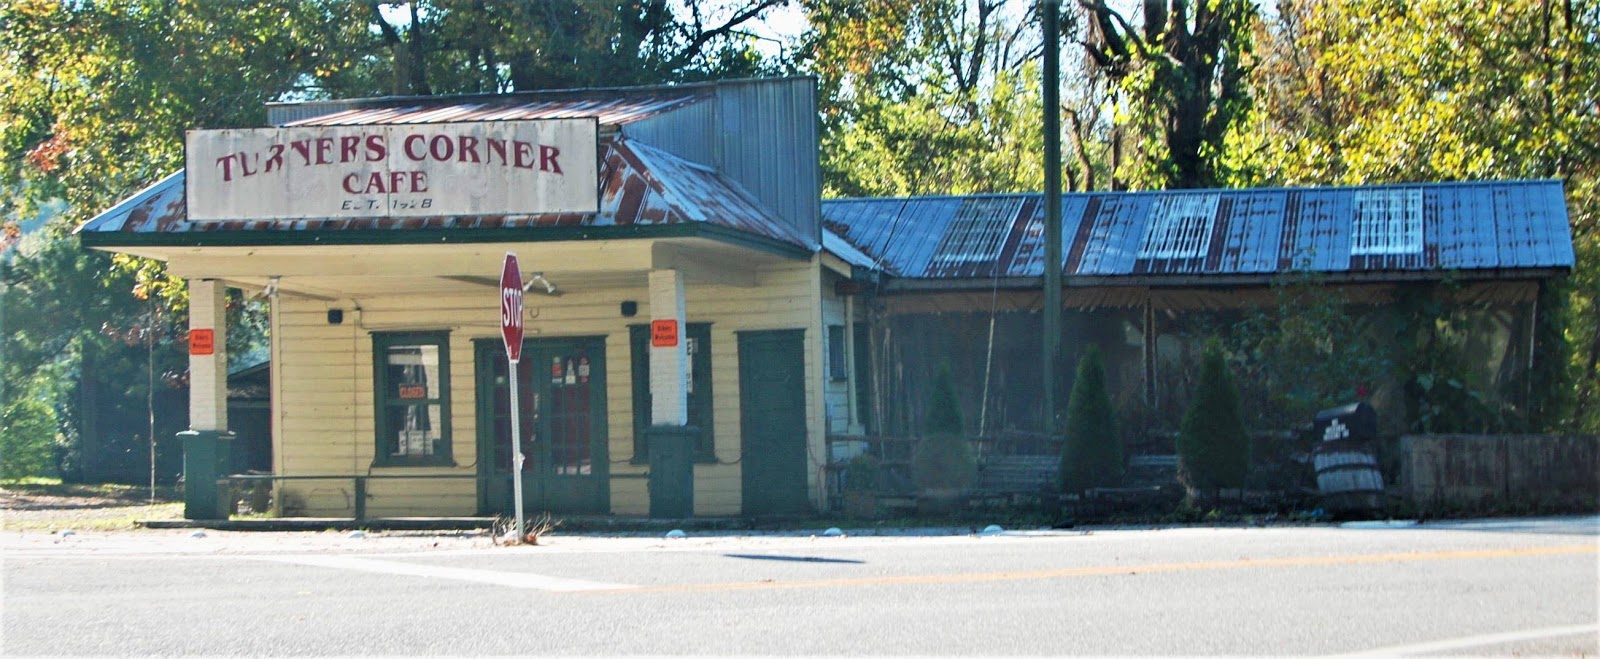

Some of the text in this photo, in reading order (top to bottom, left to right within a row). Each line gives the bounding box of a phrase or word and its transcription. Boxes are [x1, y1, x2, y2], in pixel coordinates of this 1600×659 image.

[404, 134, 563, 175] CORNER
[342, 171, 428, 194] CAFE
[503, 287, 522, 327] STOP
